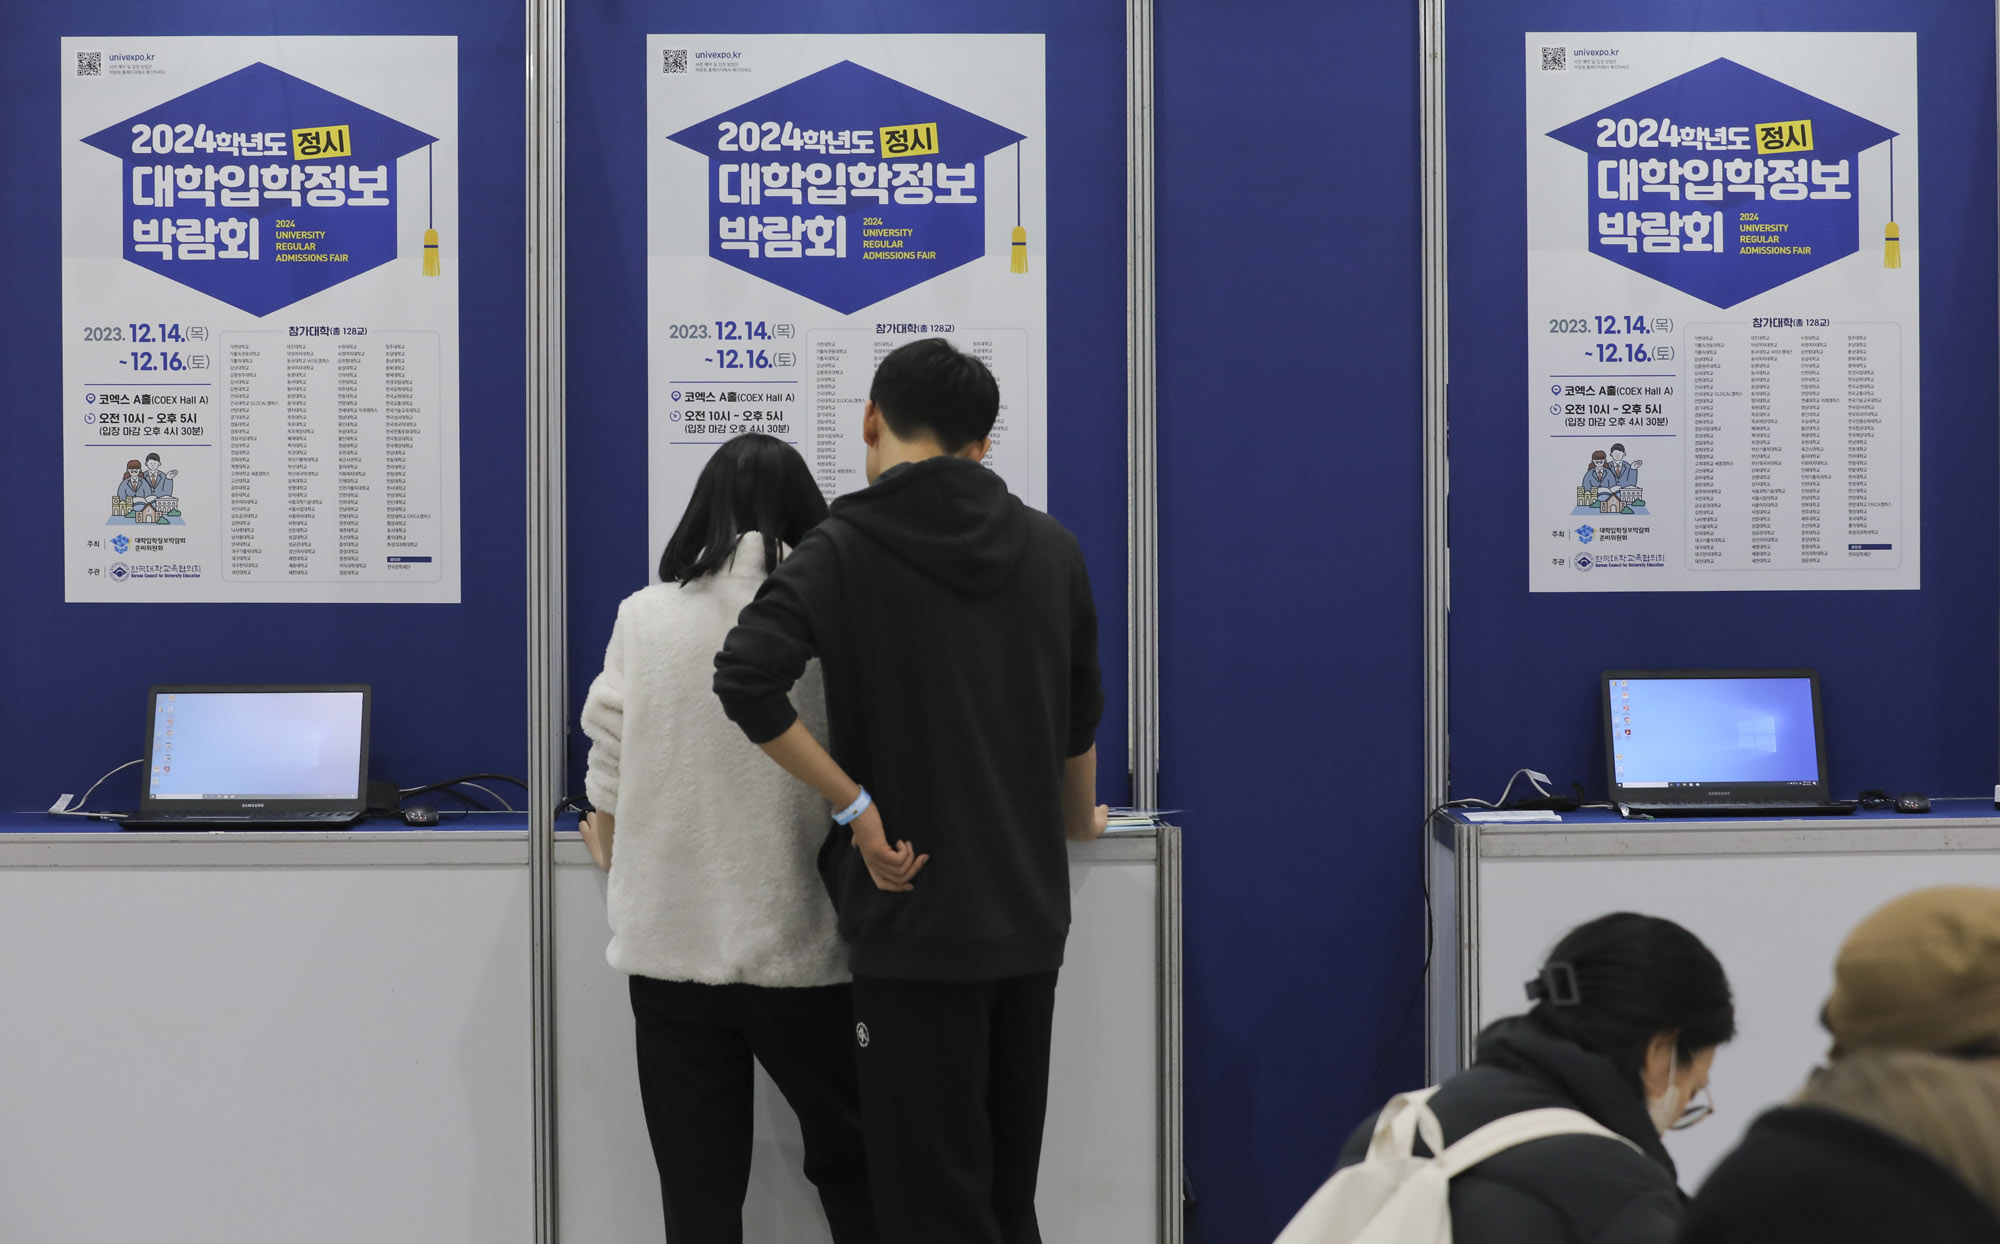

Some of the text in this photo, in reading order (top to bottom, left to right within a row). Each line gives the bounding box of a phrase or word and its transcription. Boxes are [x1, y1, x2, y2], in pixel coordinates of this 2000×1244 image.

[109, 53, 155, 61] univexpo.kr
[696, 51, 741, 59] univexpo.kr
[718, 121, 932, 154] 2024학년도 정시
[1597, 118, 1807, 150] 2024학년도 정시
[132, 124, 345, 156] 2024학년도 정시
[719, 162, 977, 205] 대학입학정보
[1598, 158, 1851, 201] 대학입학정보
[133, 164, 389, 207] 대학입학정보
[863, 217, 883, 225] 2024
[1740, 213, 1759, 221] 2024
[276, 220, 295, 228] 2024
[1740, 224, 1788, 232] UNIVERSITY
[276, 231, 325, 239] UNIVERSITY
[720, 215, 846, 258] 박람회
[863, 229, 913, 237] UNIVERSITY
[1599, 211, 1723, 253] 박람회
[133, 218, 259, 260] 박람회
[863, 240, 903, 248] REGULAR
[1740, 235, 1779, 243] REGULAR
[276, 242, 316, 250] REGULAR
[1738, 247, 1810, 255] ADMISSIONS FAIR
[276, 254, 348, 262] ADMISSIONS FAIR
[863, 252, 936, 260] ADMISSIONS FAIR
[1550, 315, 1673, 334] 2023. 12.14.(목)
[1753, 318, 1803, 328] 참가대학(총
[84, 323, 208, 342] 2023. 12.14.(목)
[289, 326, 367, 336] 참가대학(총 128교)
[669, 321, 795, 340] 2023. 12.14.(목)
[876, 324, 927, 334] 참가대학(총
[1565, 385, 1672, 396] 코엑스 A홀(COEX Hall A)
[99, 394, 208, 405] 코엑스 A홀(COEX Hall A)
[685, 392, 715, 402] 코엑스
[719, 392, 763, 402] A홀(COEX
[784, 392, 795, 402] A)
[1565, 404, 1585, 414] 오전
[1589, 404, 1609, 414] 10시
[1622, 404, 1642, 414] 오후
[1645, 404, 1661, 414] 5시
[99, 413, 119, 423] 오전
[123, 413, 144, 423] 10시
[157, 413, 177, 423] 오후
[180, 413, 196, 423] 5시
[685, 411, 705, 421] 오전
[709, 411, 730, 421] 10시
[743, 411, 763, 421] 오후
[767, 411, 782, 421] 5시
[1565, 417, 1668, 427] (입장 마감 오후 4시 30분)
[100, 427, 203, 436] (입장 마감 오후 4시 30분)
[685, 424, 790, 434] (입장 마감 오후 4시 30분)
